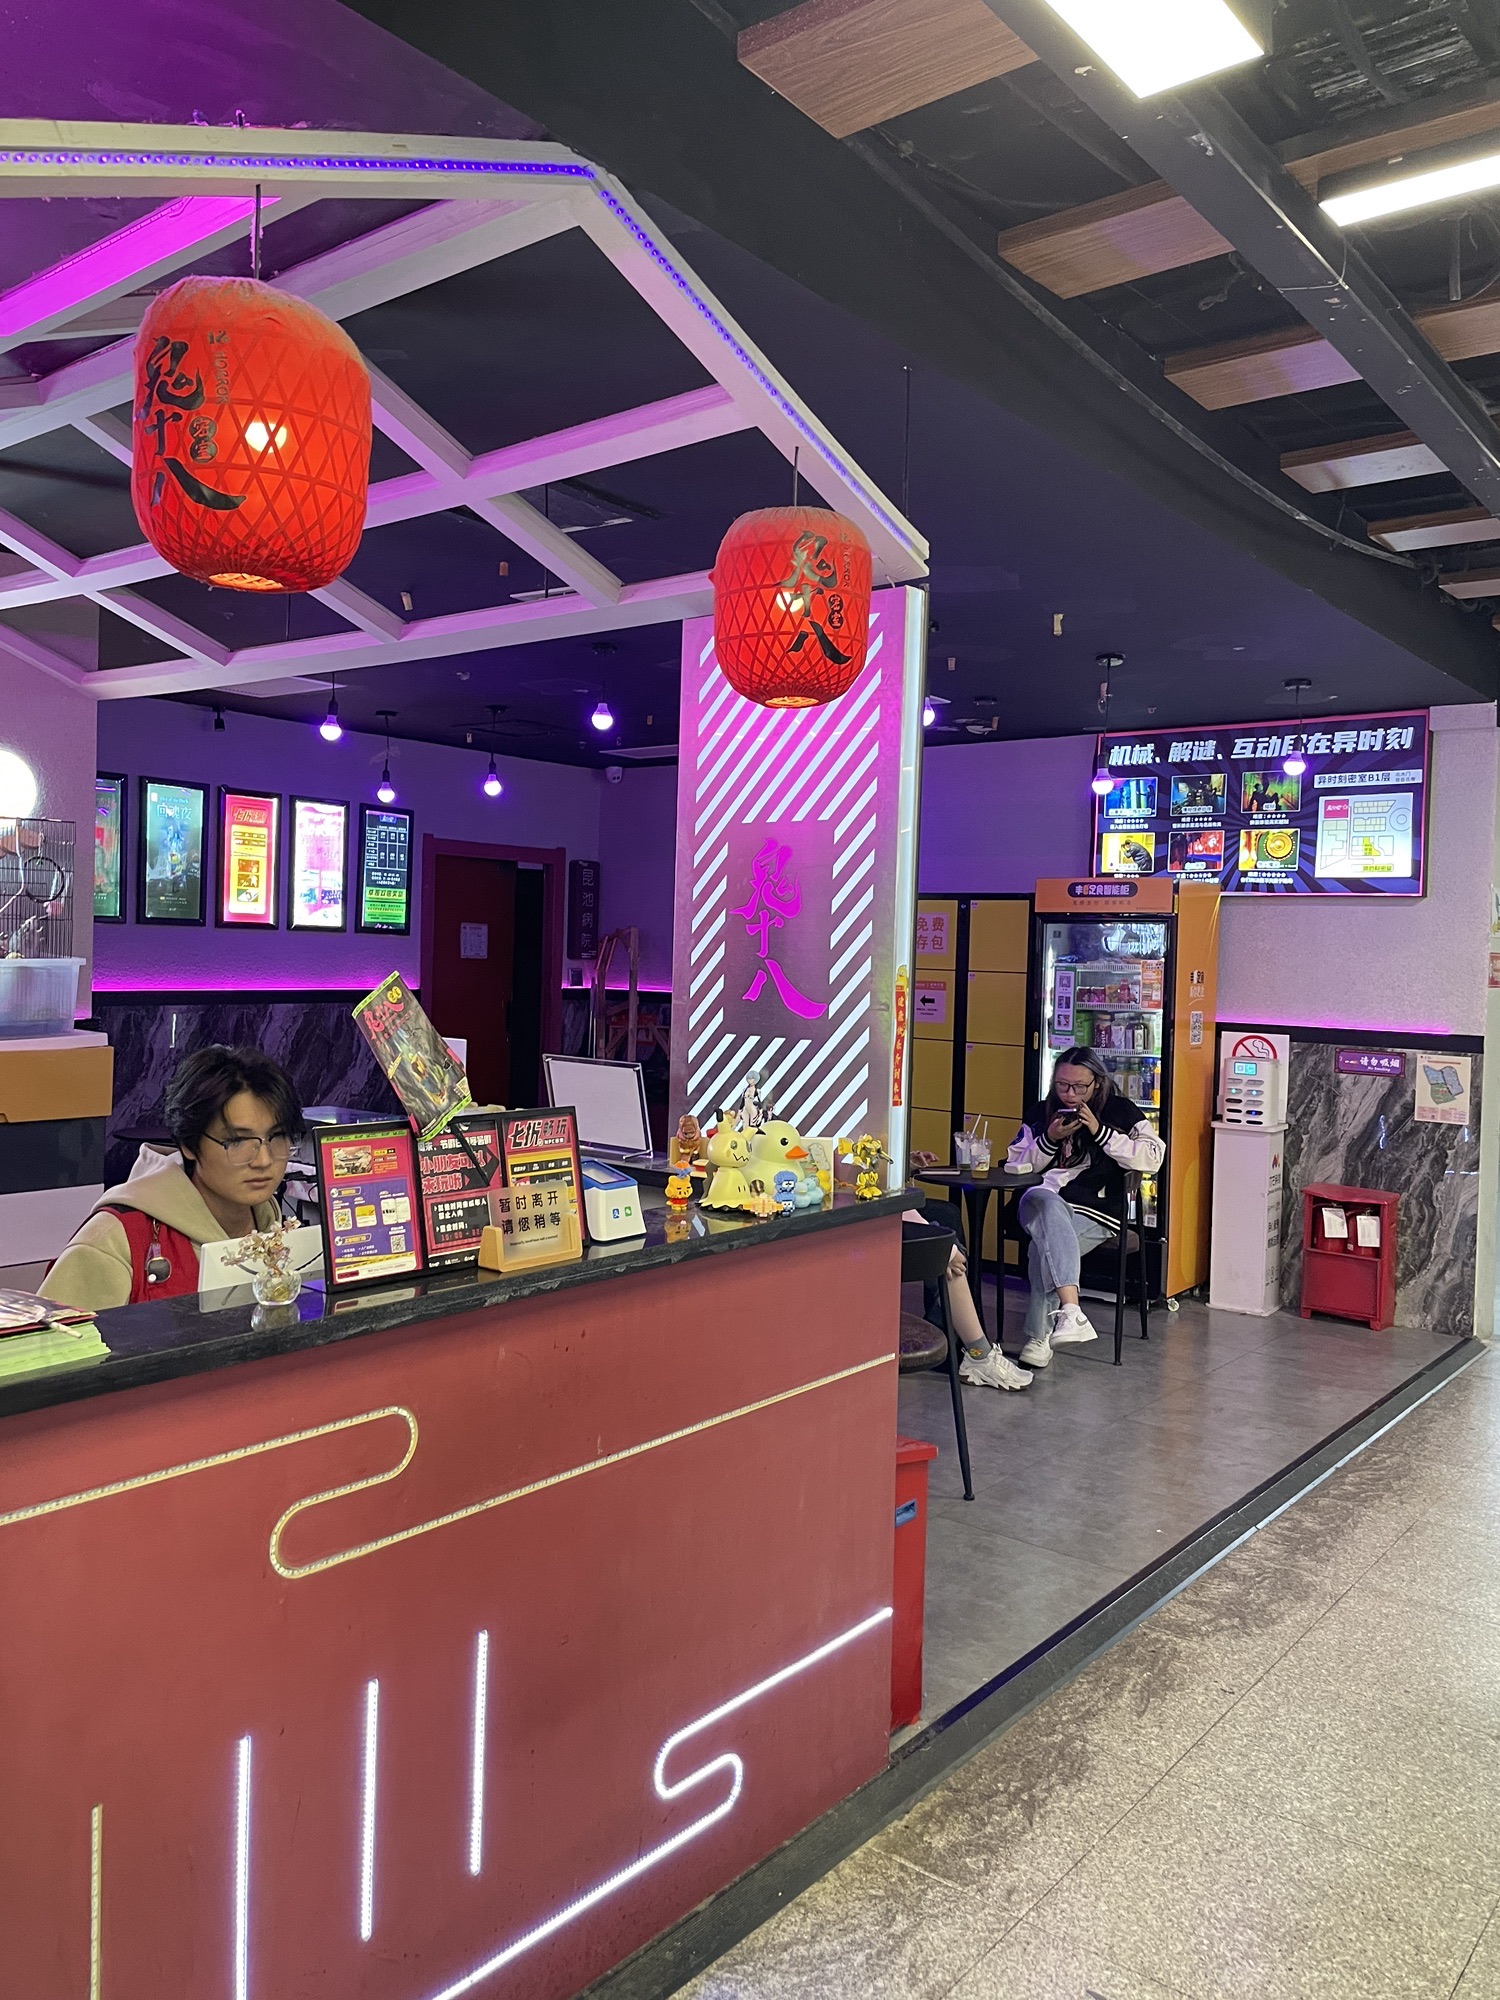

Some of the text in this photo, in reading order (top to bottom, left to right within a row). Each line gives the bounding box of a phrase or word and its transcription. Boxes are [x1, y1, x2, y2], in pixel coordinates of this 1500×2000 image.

[140, 335, 247, 511] 鬼十八
[191, 417, 216, 462] 密室
[772, 530, 852, 665] 鬼十八
[829, 594, 844, 629] 密室
[1317, 772, 1391, 785] 异时刻密室B1层
[580, 868, 595, 948] 昆池病院
[729, 838, 828, 1019] 鬼十八
[917, 916, 944, 932] 免费
[916, 935, 944, 950] 存包
[1360, 1056, 1400, 1068] 请勿吸烟
[418, 1135, 492, 1152] 周末、节假日寒暑假
[499, 1190, 558, 1214] 暂时离开
[502, 1212, 561, 1235] 请您稍等
